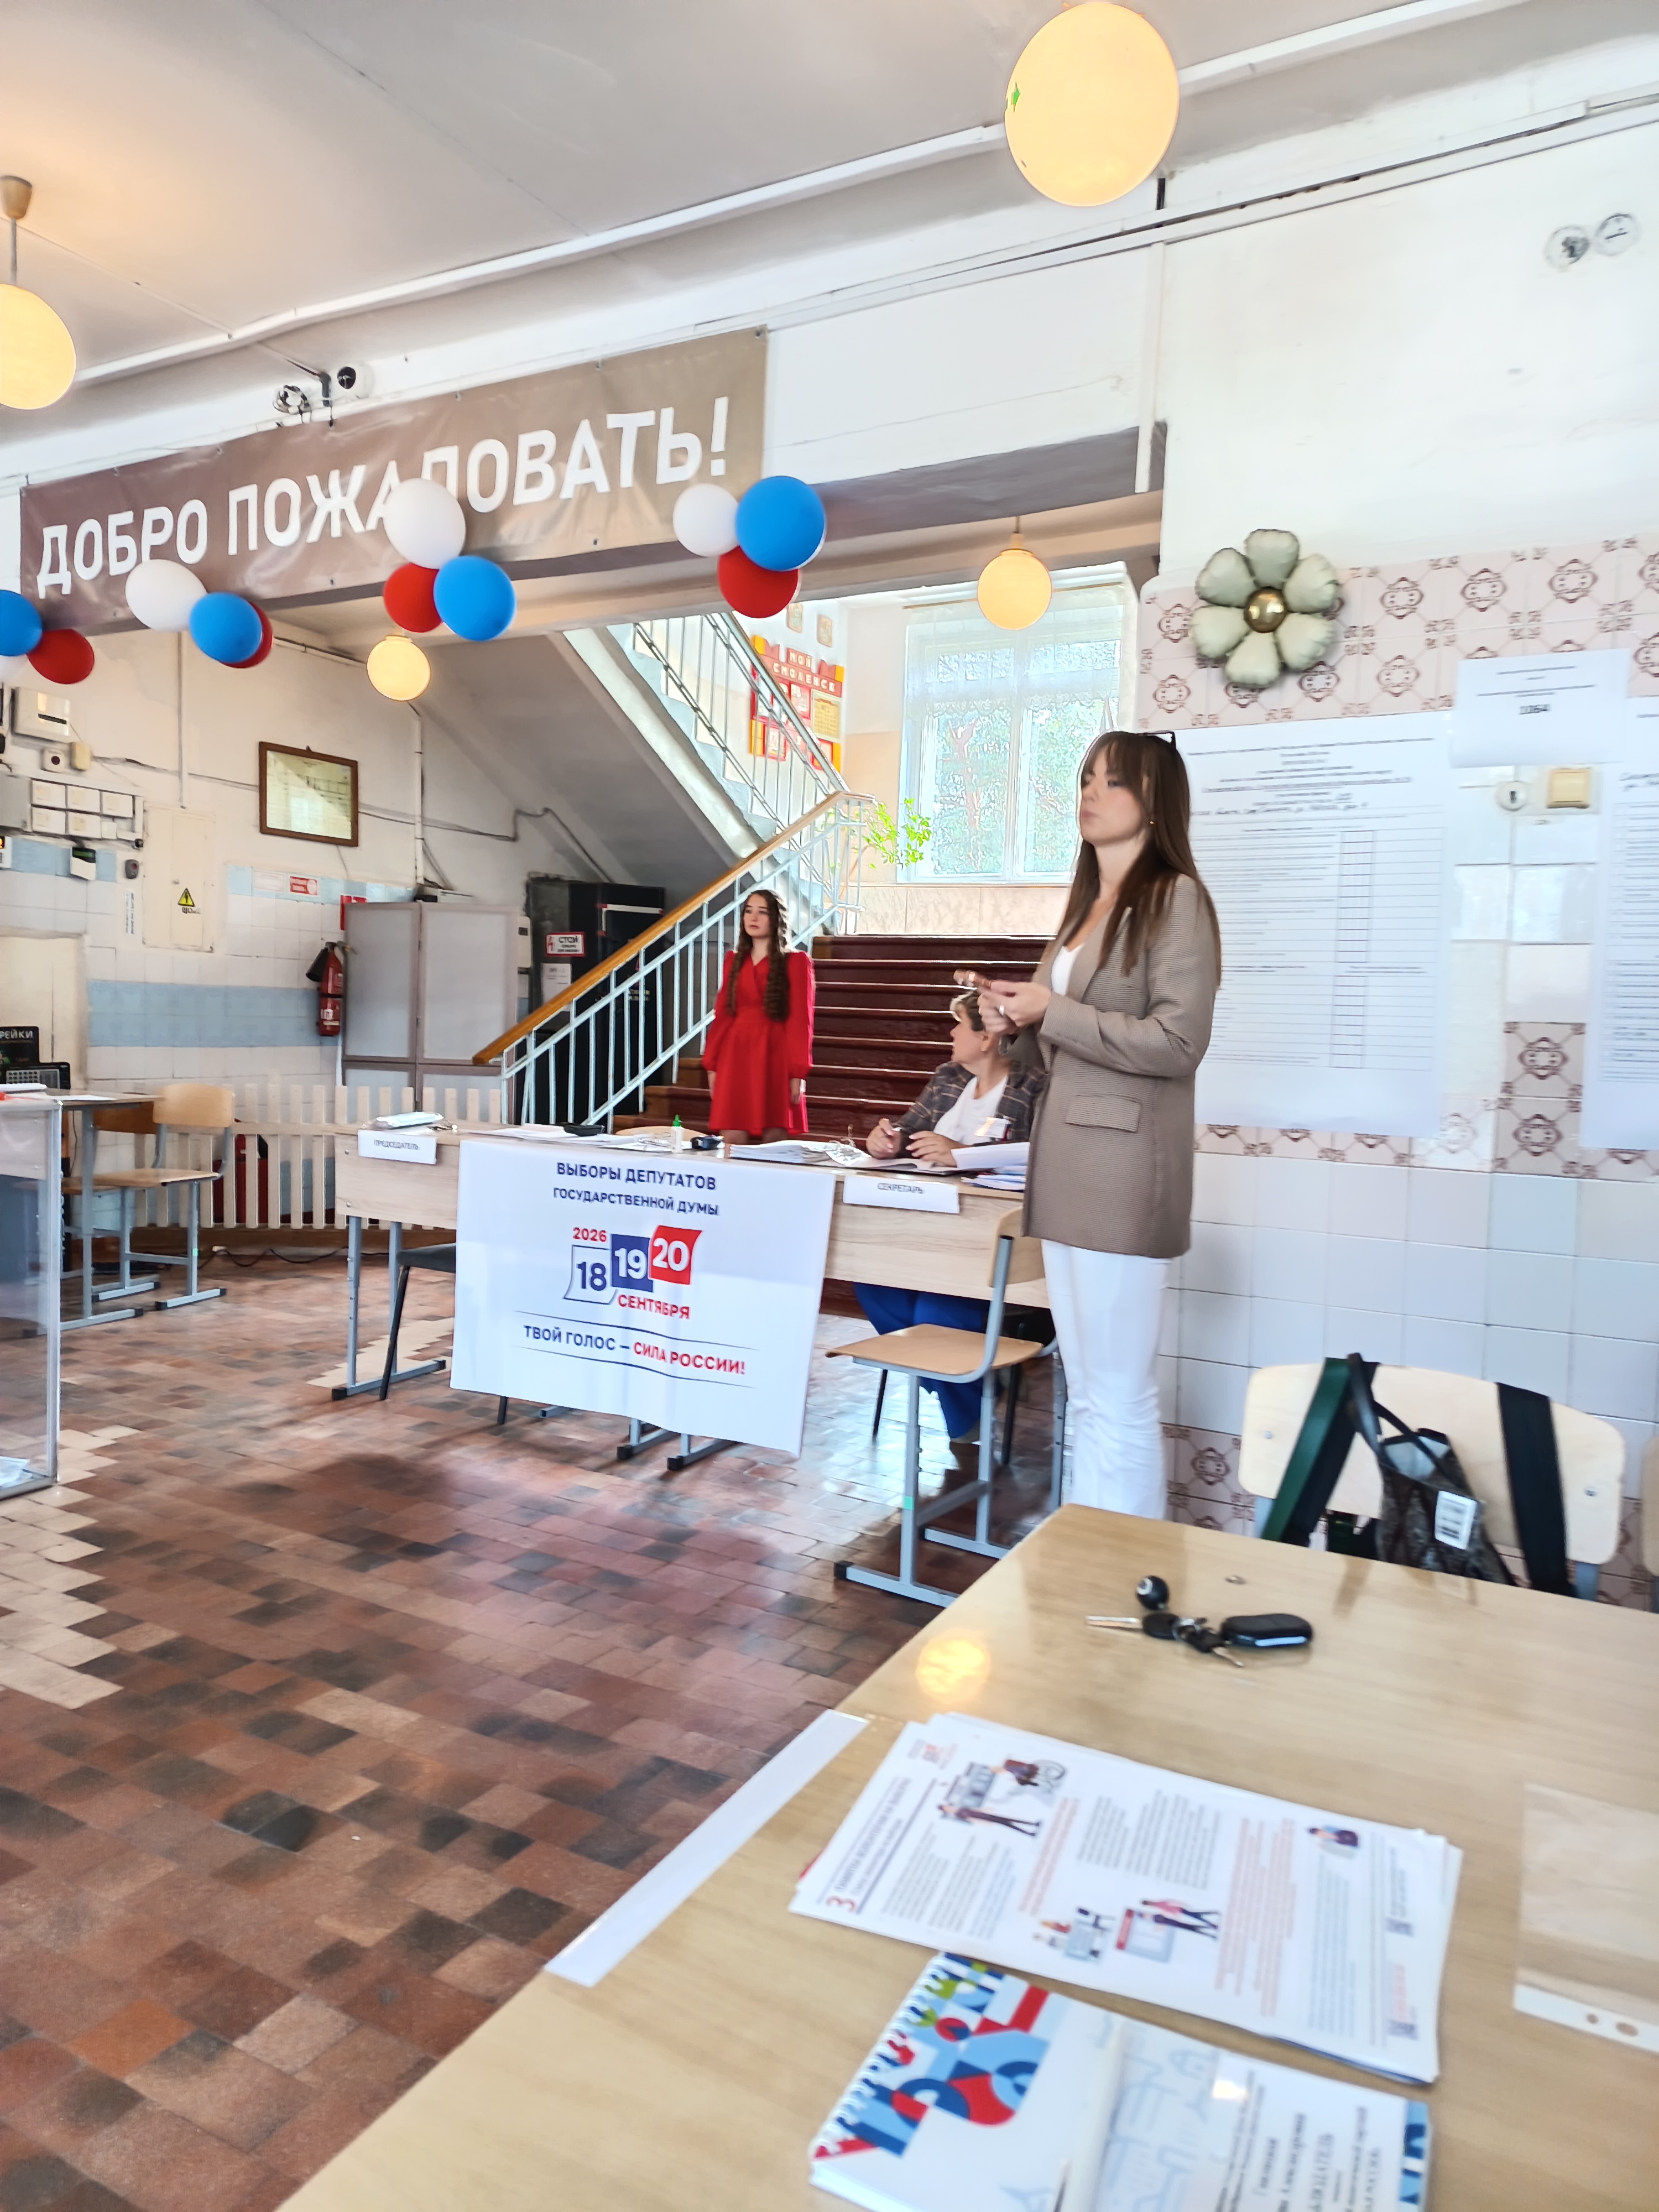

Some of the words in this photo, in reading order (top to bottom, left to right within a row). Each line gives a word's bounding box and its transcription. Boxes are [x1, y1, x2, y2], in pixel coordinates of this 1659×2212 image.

[36, 498, 208, 599] ДОБРО
[790, 651, 811, 667] МОЙ
[773, 662, 835, 692] СМОЛЕНСК
[556, 1162, 622, 1181] ВЫБОРЫ
[625, 1168, 717, 1191] ДЕПУТАТОВ
[553, 1187, 674, 1211] ГОСУДАРСТВЕННОЙ
[677, 1201, 718, 1216] ДУМЫ
[573, 1227, 607, 1243] 2026
[577, 1261, 607, 1291] 18
[614, 1248, 647, 1279] 19
[653, 1238, 690, 1272] 20
[618, 1293, 691, 1320] СЕНТЯБРЯ
[524, 1324, 562, 1343] ТВОЙ
[566, 1332, 615, 1350] ГОЛОС
[633, 1340, 666, 1363] СИЛА
[670, 1350, 745, 1375] РОССИИ!
